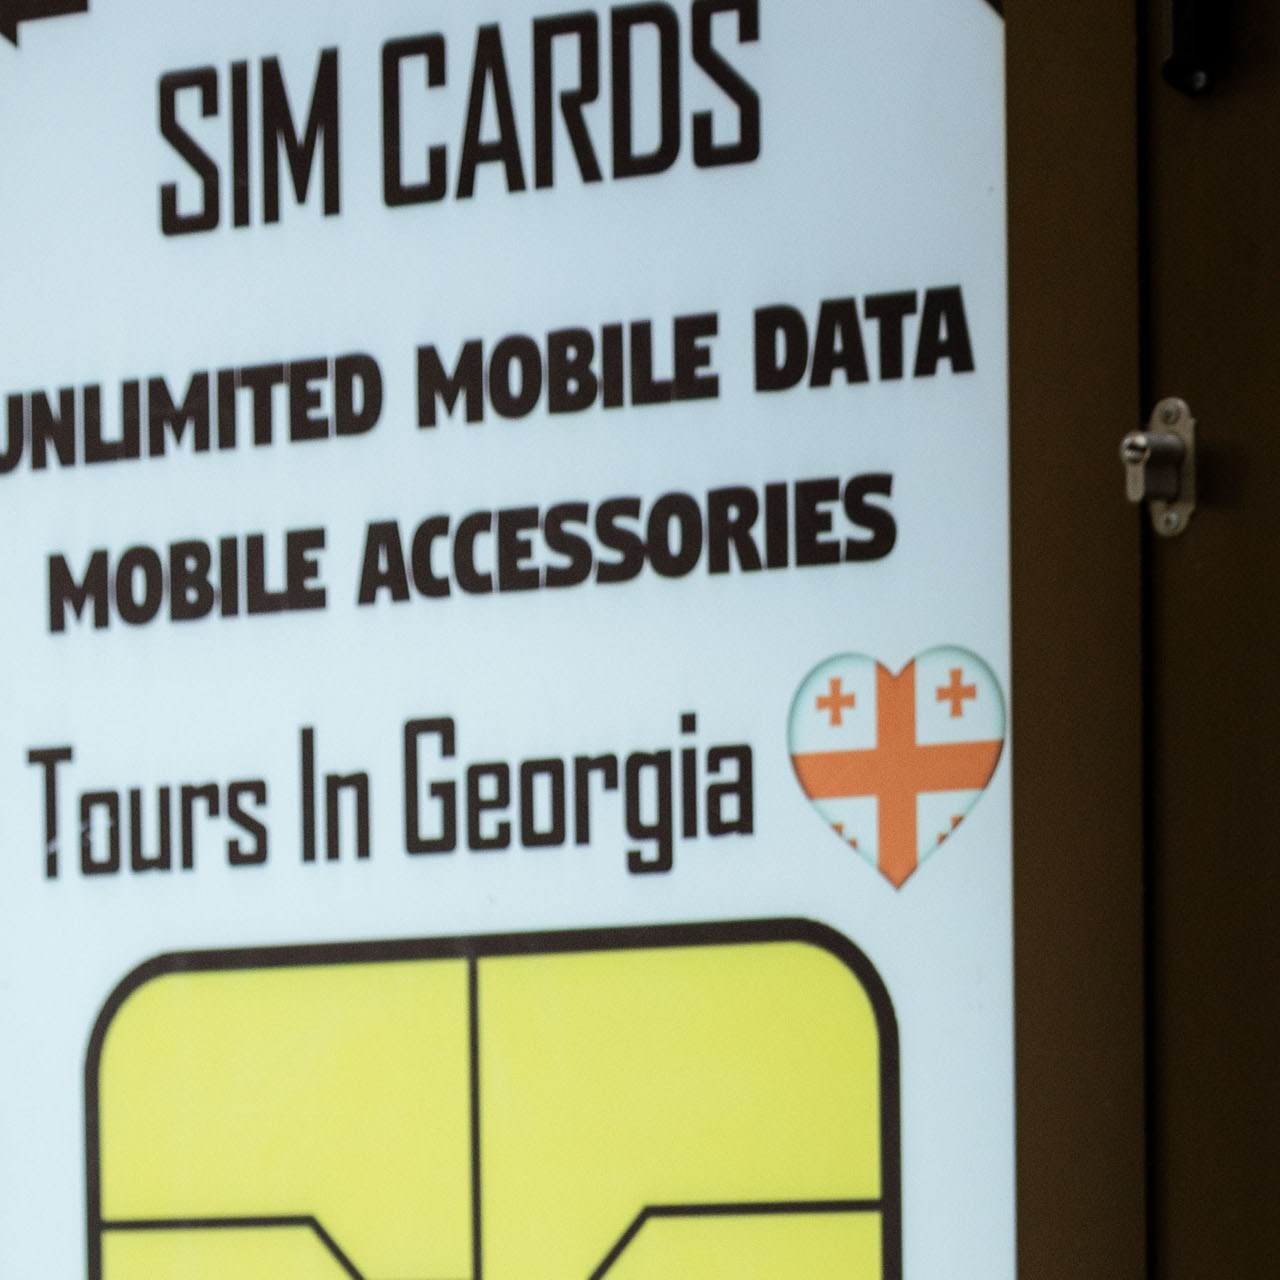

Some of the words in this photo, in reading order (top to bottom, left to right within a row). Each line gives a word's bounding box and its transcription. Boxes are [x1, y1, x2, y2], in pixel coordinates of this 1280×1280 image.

[158, 46, 341, 238] SIM
[380, 0, 762, 209] CARDS
[416, 311, 720, 430] MOBILE
[753, 283, 976, 394] DATA
[47, 527, 327, 634] MOBILE
[357, 472, 898, 606] ACCESSORIES
[27, 746, 268, 879] Tours
[299, 726, 371, 863] In
[403, 712, 754, 876] Georgia
